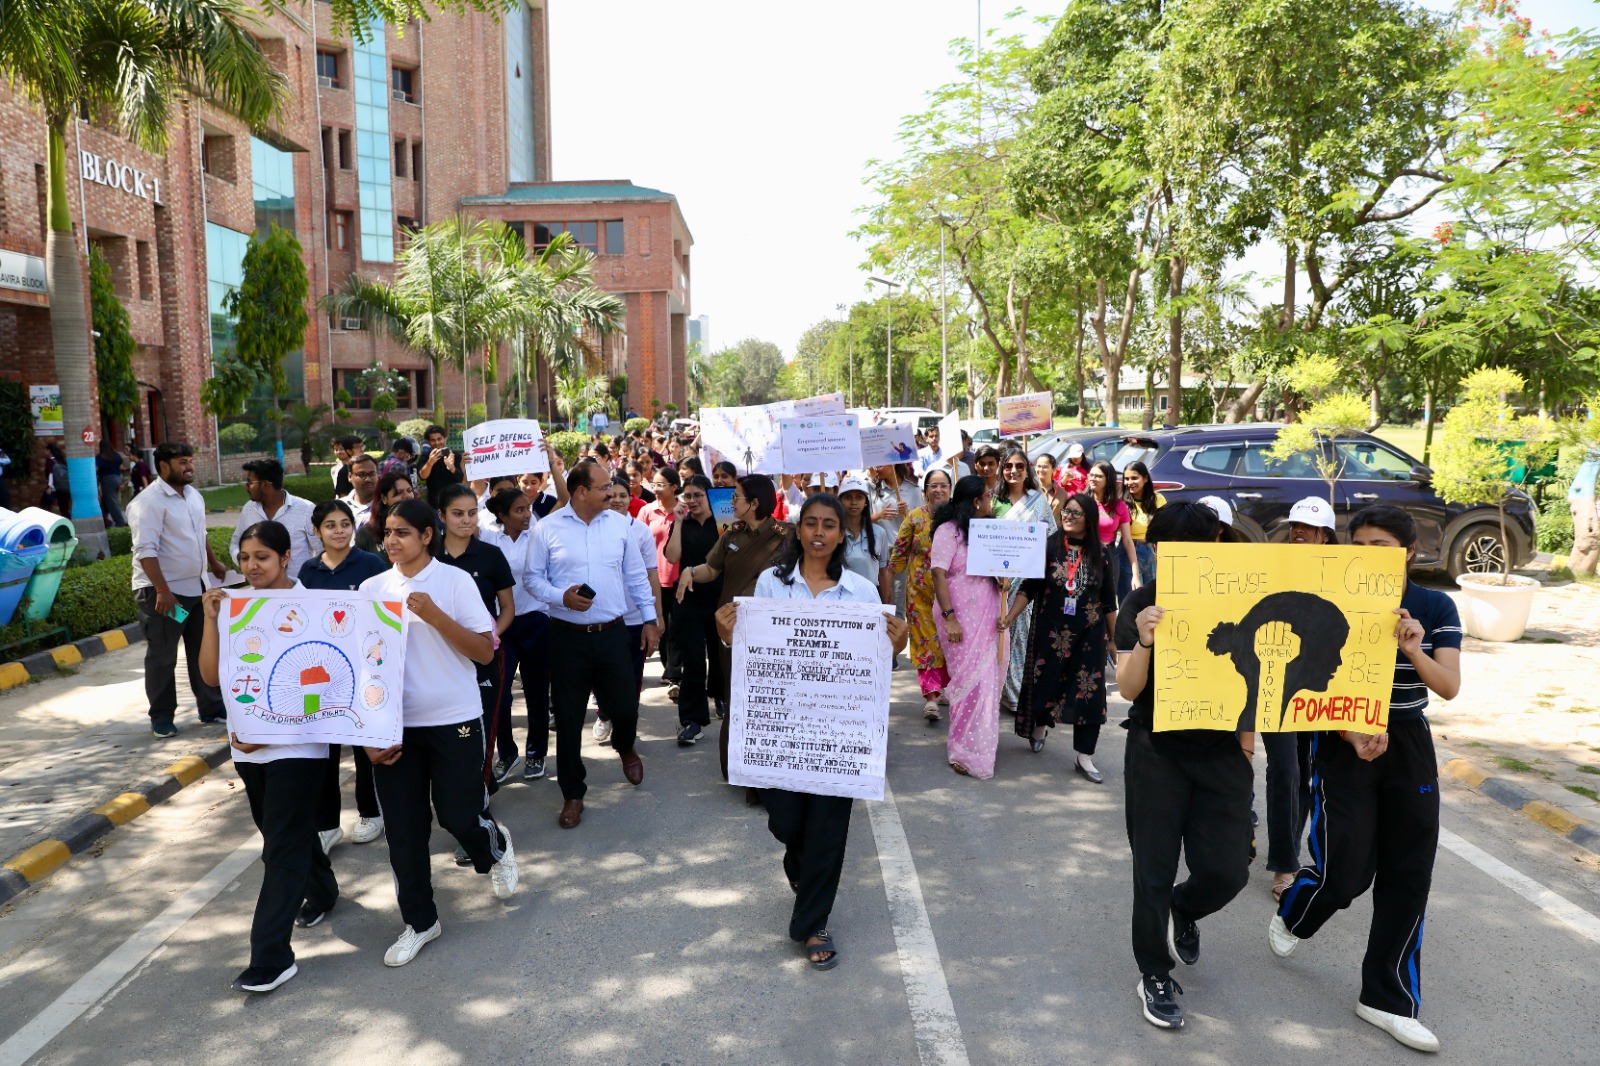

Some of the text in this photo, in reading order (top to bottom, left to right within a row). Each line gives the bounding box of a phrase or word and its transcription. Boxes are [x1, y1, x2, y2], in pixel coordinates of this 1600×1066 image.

[81, 150, 162, 204] BLOCK-1
[22, 277, 44, 288] BLOCK
[472, 433, 532, 448] SELF DEFENCE
[474, 448, 531, 464] HUMAN RIGHT
[1159, 555, 1188, 594] I
[1310, 556, 1338, 594] I
[771, 616, 876, 630] THE CONSTITUTION OF
[794, 628, 827, 638] INDIA
[786, 638, 840, 649] PREAMBLE
[766, 647, 786, 656] THE
[789, 648, 815, 658] PEOPLE
[1258, 648, 1292, 658] WOMEN
[747, 669, 798, 680] DEMOCRATIC
[836, 668, 871, 677] SECULAR
[748, 695, 786, 706] LIBERTY
[1262, 660, 1276, 729] POWER
[261, 710, 317, 724] FUNDAMENTAL
[747, 710, 789, 720] EQUALITY
[1292, 696, 1387, 728] POWERFUL
[746, 722, 796, 734] FRATERNITY
[746, 737, 756, 746] IN
[760, 739, 778, 747] OUR
[781, 740, 838, 752] CONSTITUENT
[744, 759, 860, 776] OURSELVES THIS CONSTITUTION
